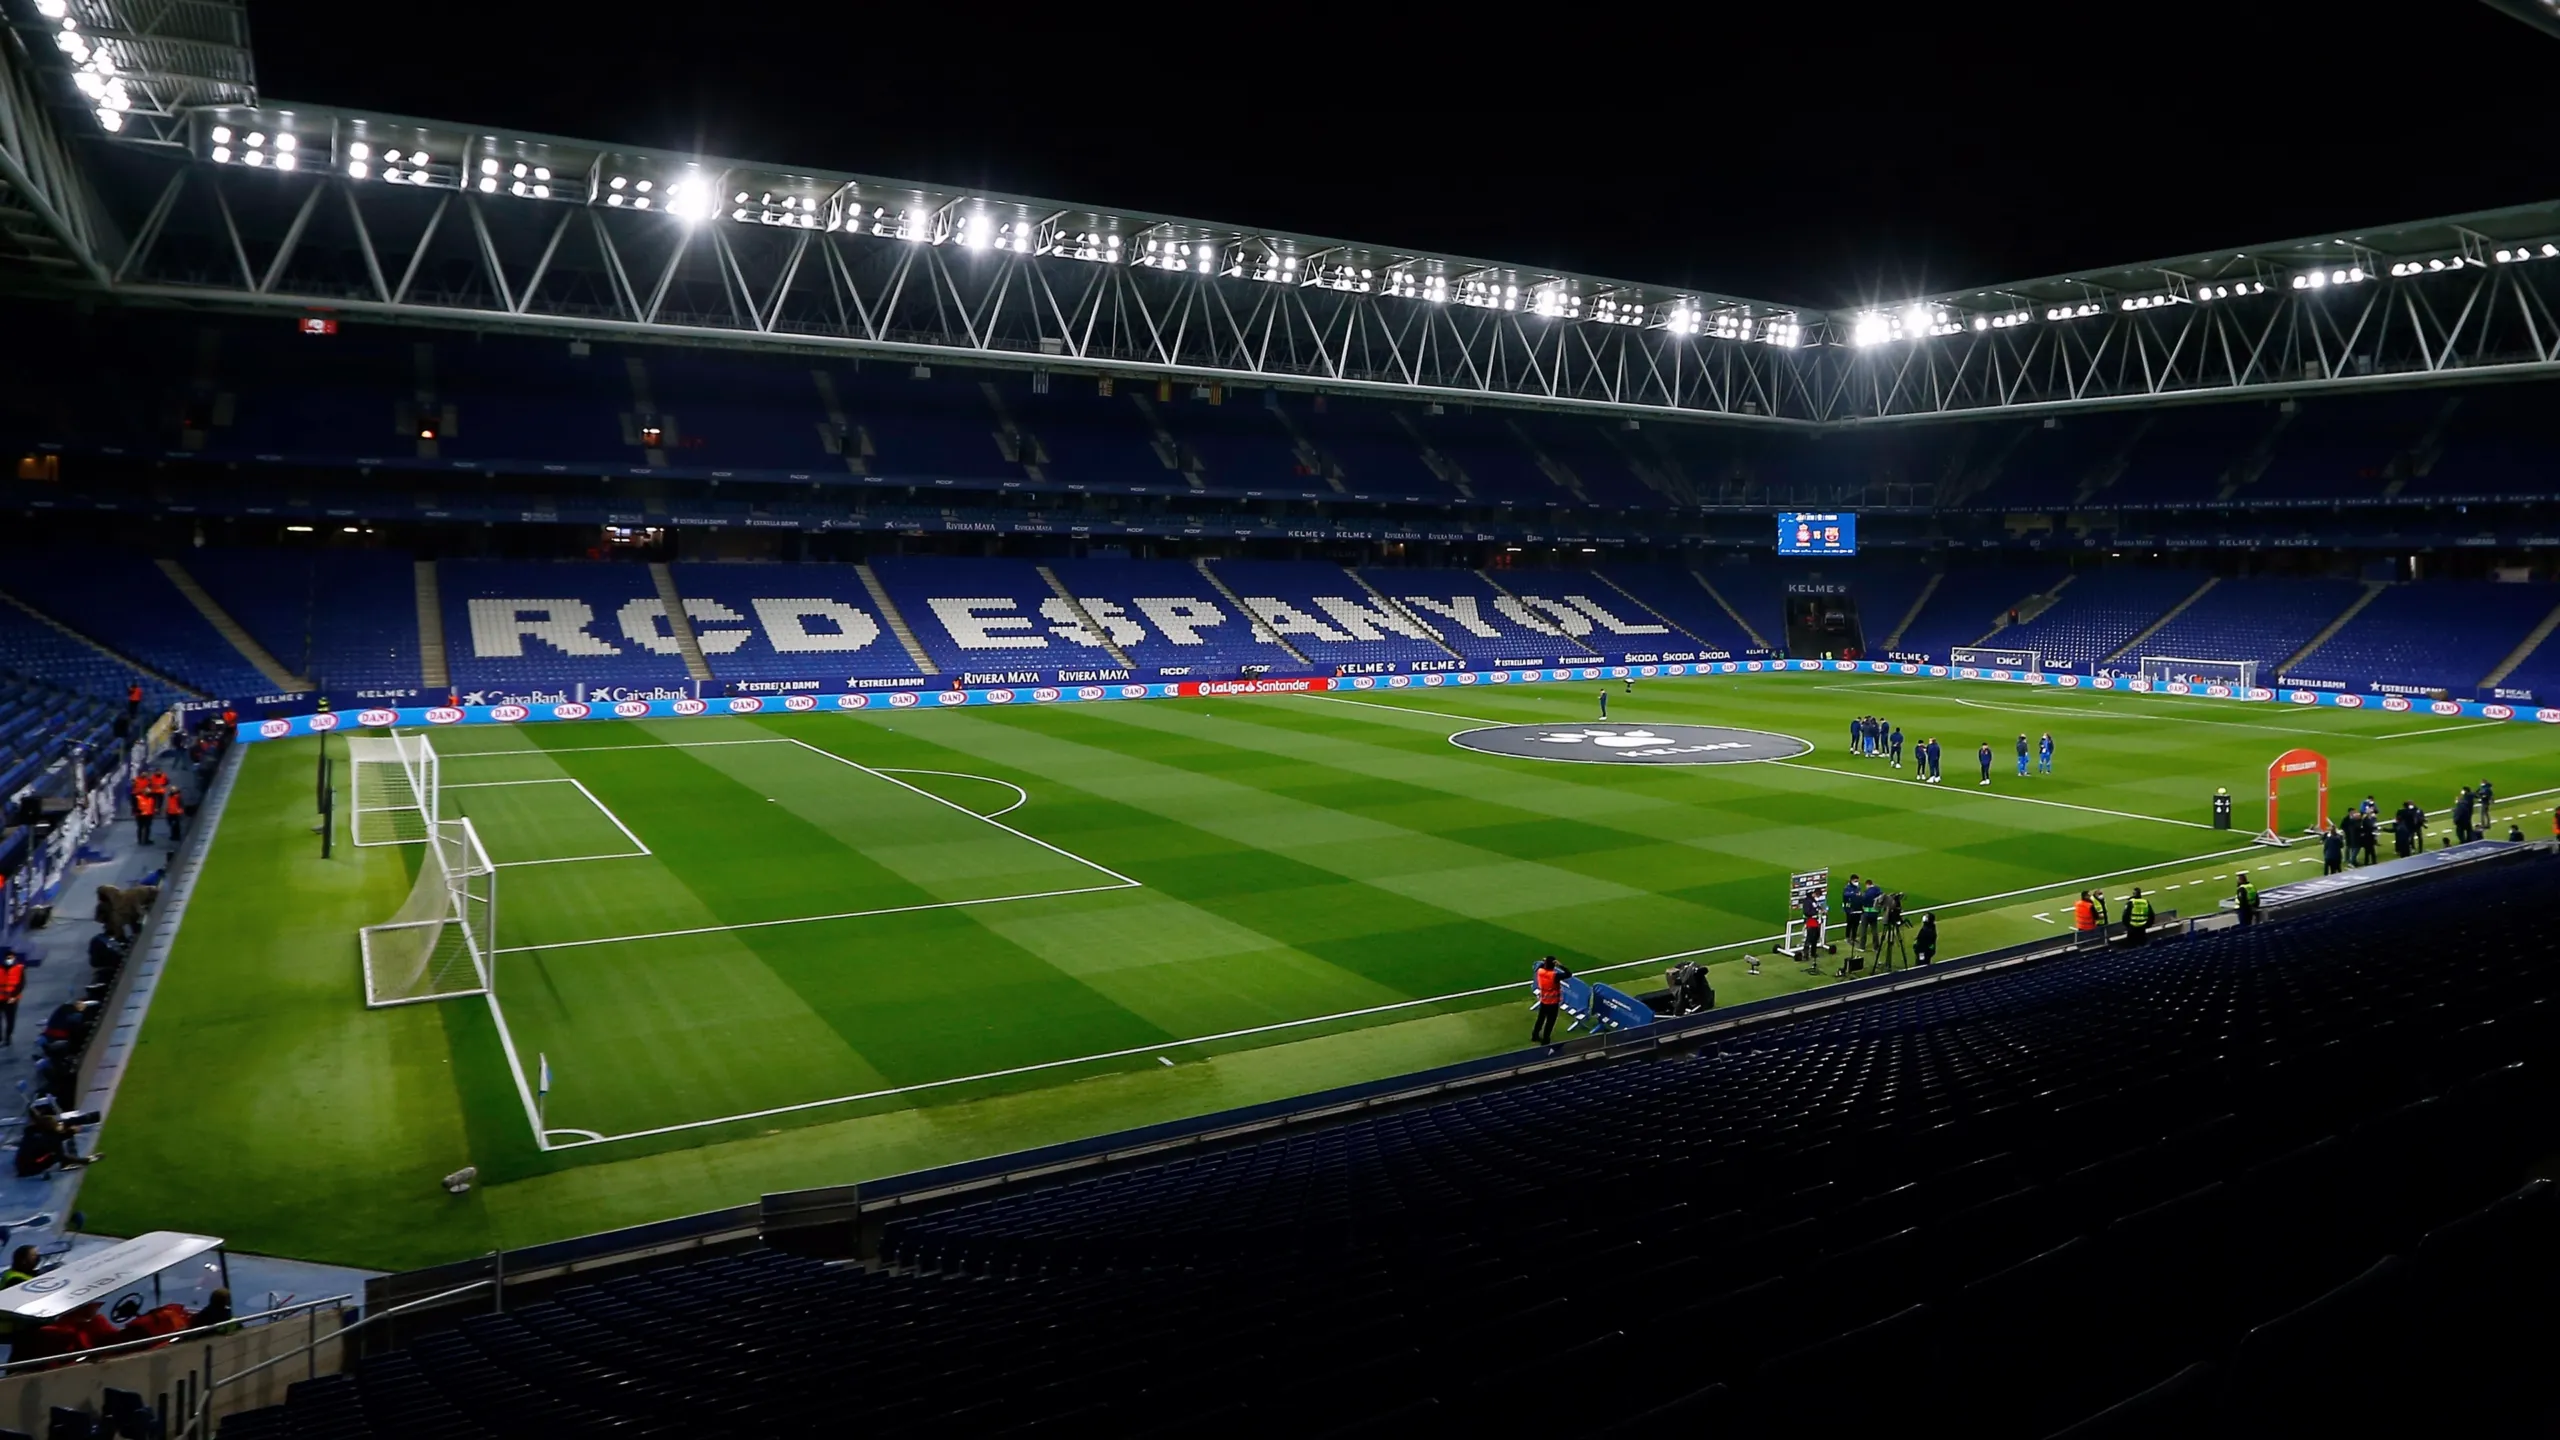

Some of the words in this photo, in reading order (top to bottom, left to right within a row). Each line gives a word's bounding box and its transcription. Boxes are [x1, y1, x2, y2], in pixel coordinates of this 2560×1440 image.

[946, 522, 973, 531] RIVIERA
[975, 523, 995, 531] MAYA
[1788, 584, 1834, 593] KELME
[468, 599, 880, 657] RCD
[927, 596, 1669, 650] ESPANYOL
[1566, 656, 1589, 664] ESTRELLA
[1625, 652, 1658, 663] ŠKODA
[1662, 652, 1696, 662] ŠKODA
[1699, 650, 1730, 660] ŠKODA
[1889, 652, 1922, 661] KELME
[1951, 654, 1975, 663] DIGI
[1412, 661, 1455, 671] KELME
[1501, 659, 1526, 667] ESTRELLA
[1527, 658, 1544, 666] DAMM
[1997, 657, 2022, 666] DIGI
[2045, 659, 2072, 669] DIGI
[1340, 663, 1384, 673] KELME
[964, 672, 1006, 684] RIVIERA
[1008, 671, 1040, 683] MAYA
[1058, 670, 1097, 682] RIVIERA
[1100, 669, 1130, 680] MAYA
[793, 680, 820, 690] DAMM
[860, 679, 898, 688] ESTRELLA
[899, 678, 924, 687] DAMM
[1212, 682, 1246, 694] LaLiga
[1256, 680, 1310, 692] Santander
[2287, 679, 2322, 688] ESTRELLA
[2322, 681, 2346, 689] DAMM
[357, 690, 405, 698] KELME
[613, 687, 688, 700] CaixaBank
[1037, 690, 1055, 698] DANI
[1082, 689, 1099, 697] DANI
[2380, 685, 2420, 694] ESTRELLA
[256, 694, 294, 704] KELME
[893, 695, 913, 703] DANI
[990, 692, 1009, 700] DANI
[734, 701, 755, 709] DANI
[790, 699, 810, 707] DANI
[842, 697, 862, 705] DANI
[558, 705, 581, 714] DANI
[619, 703, 642, 712] DANI
[677, 702, 700, 710] DANI
[431, 711, 455, 719] DANI
[495, 707, 520, 716] DANI
[314, 717, 333, 726] DANI
[363, 713, 388, 721] DANI
[265, 725, 284, 733] DANI
